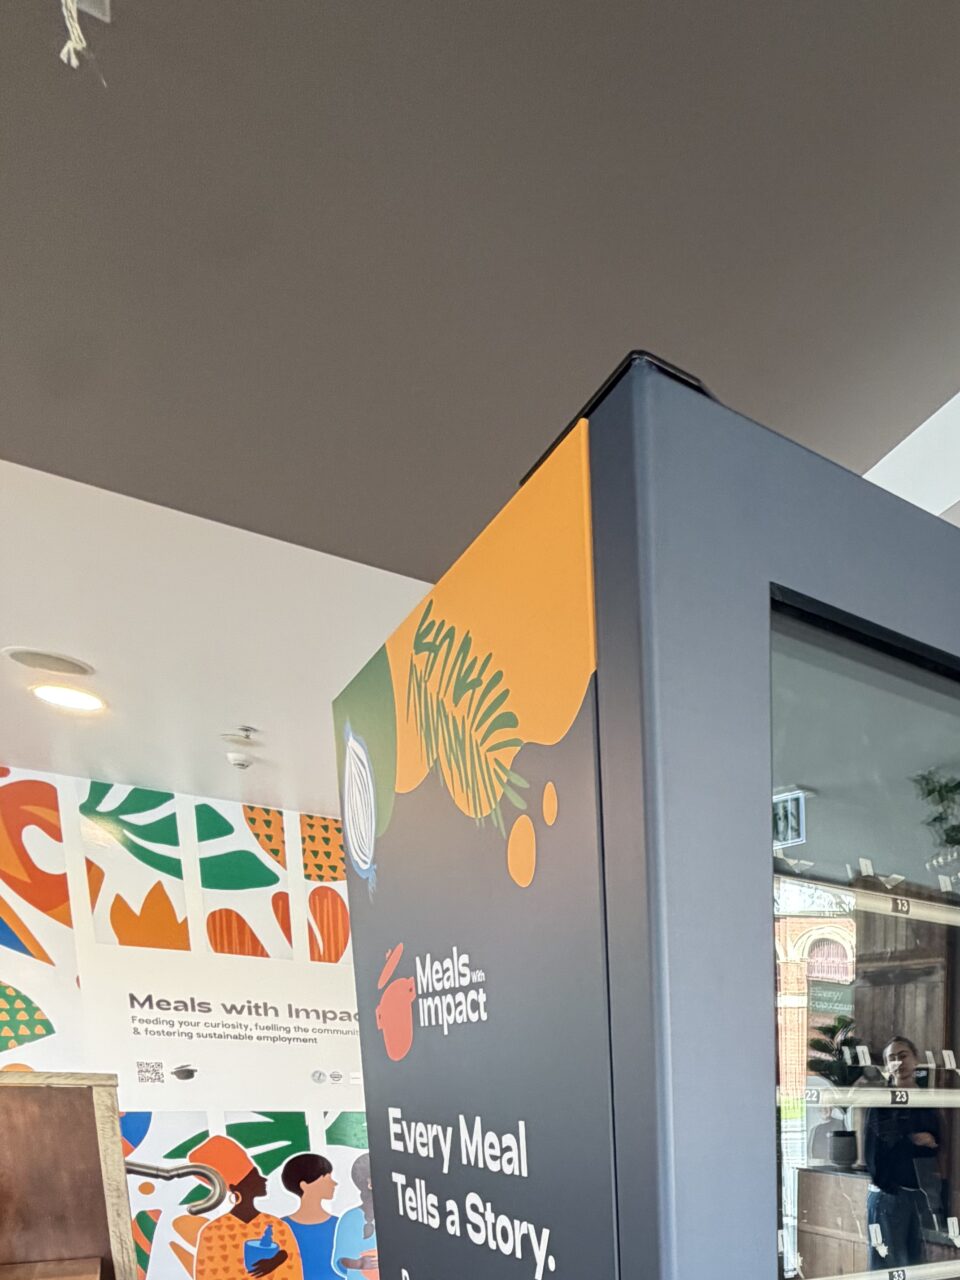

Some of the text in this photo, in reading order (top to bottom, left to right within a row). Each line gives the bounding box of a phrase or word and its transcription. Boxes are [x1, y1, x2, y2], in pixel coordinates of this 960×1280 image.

[897, 900, 908, 911] 13
[416, 946, 470, 994] Meals
[129, 993, 359, 1024] Meals with Impac
[131, 1015, 175, 1028] Feeding
[178, 1020, 201, 1028] your
[204, 1020, 253, 1031] curiosity,
[255, 1022, 291, 1033] fuelling
[293, 1025, 309, 1033] the
[133, 1027, 318, 1044] & fostering sustainable employment
[805, 1090, 818, 1101] 22
[895, 1092, 907, 1102] 23
[388, 1107, 528, 1177] Every Meal
[391, 1171, 556, 1280] Tells a Story.
